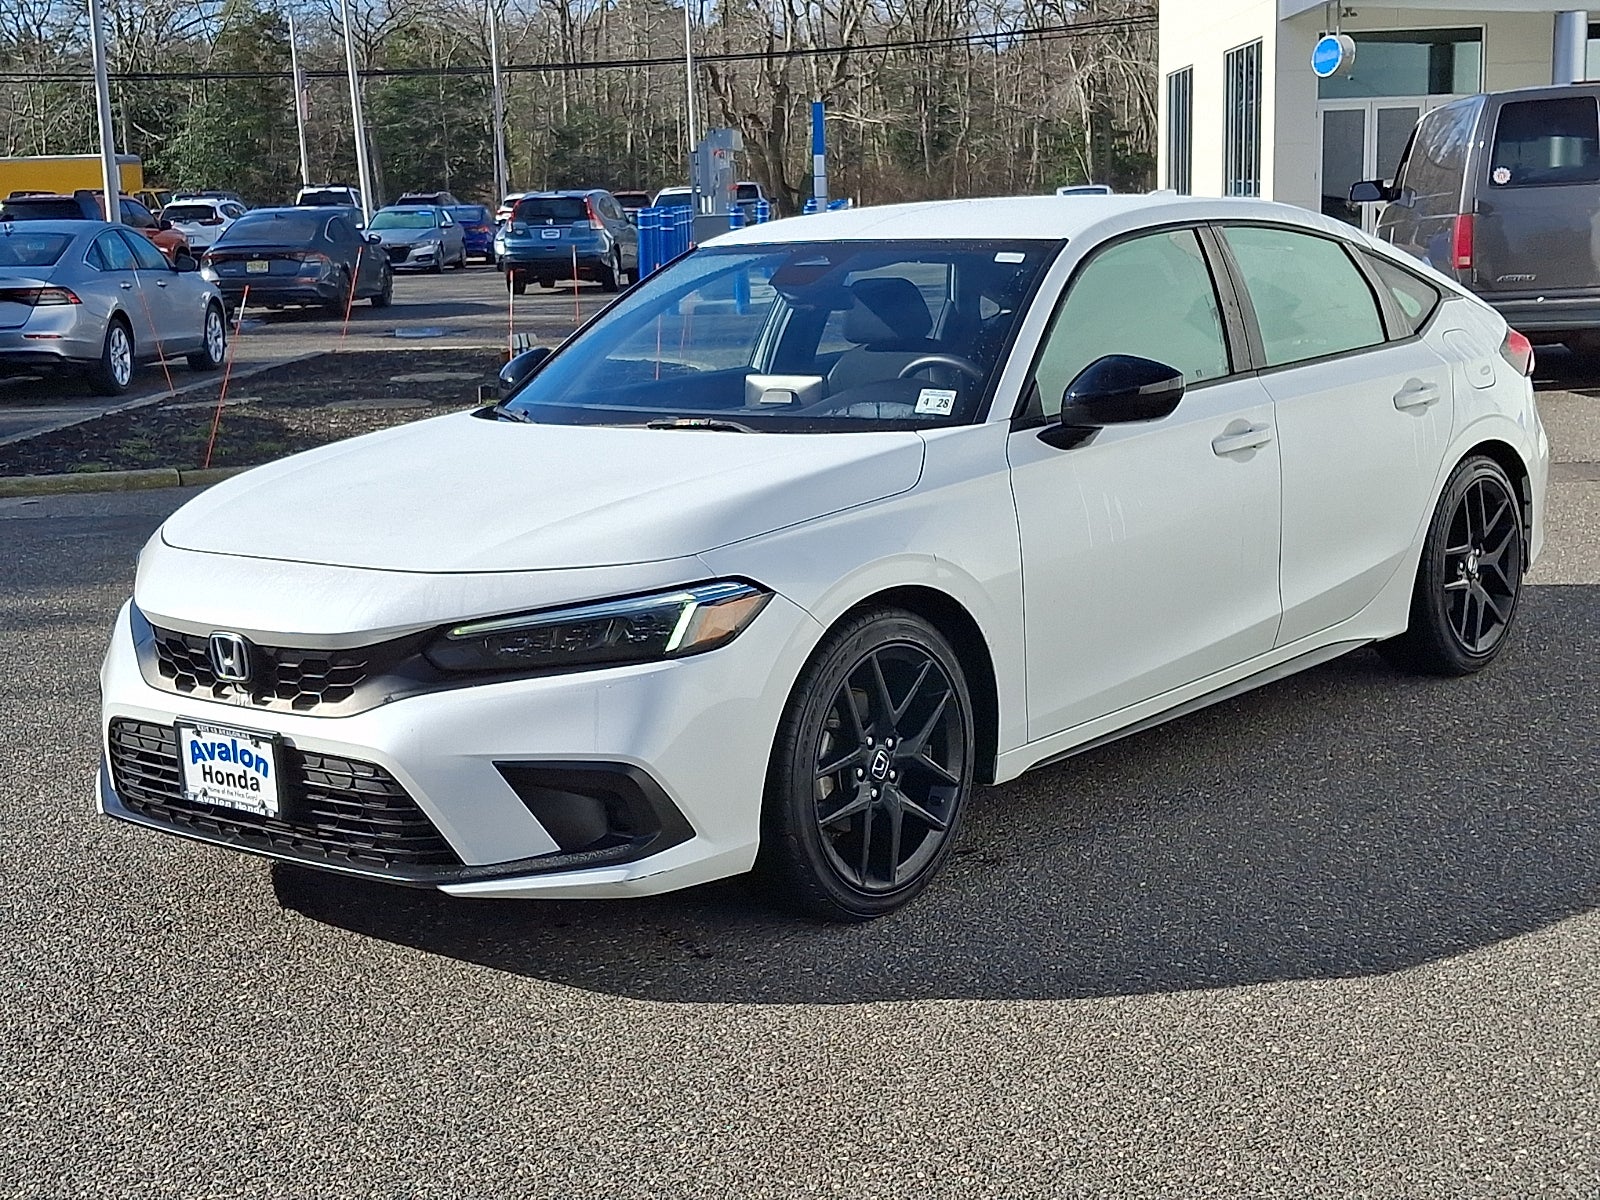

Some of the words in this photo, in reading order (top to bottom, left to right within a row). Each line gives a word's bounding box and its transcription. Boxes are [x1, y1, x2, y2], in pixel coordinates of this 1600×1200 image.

[936, 398, 950, 408] 28
[190, 738, 269, 779] Avalon
[202, 763, 261, 793] Honda
[196, 794, 232, 808] Avalon
[234, 801, 266, 816] Honda
